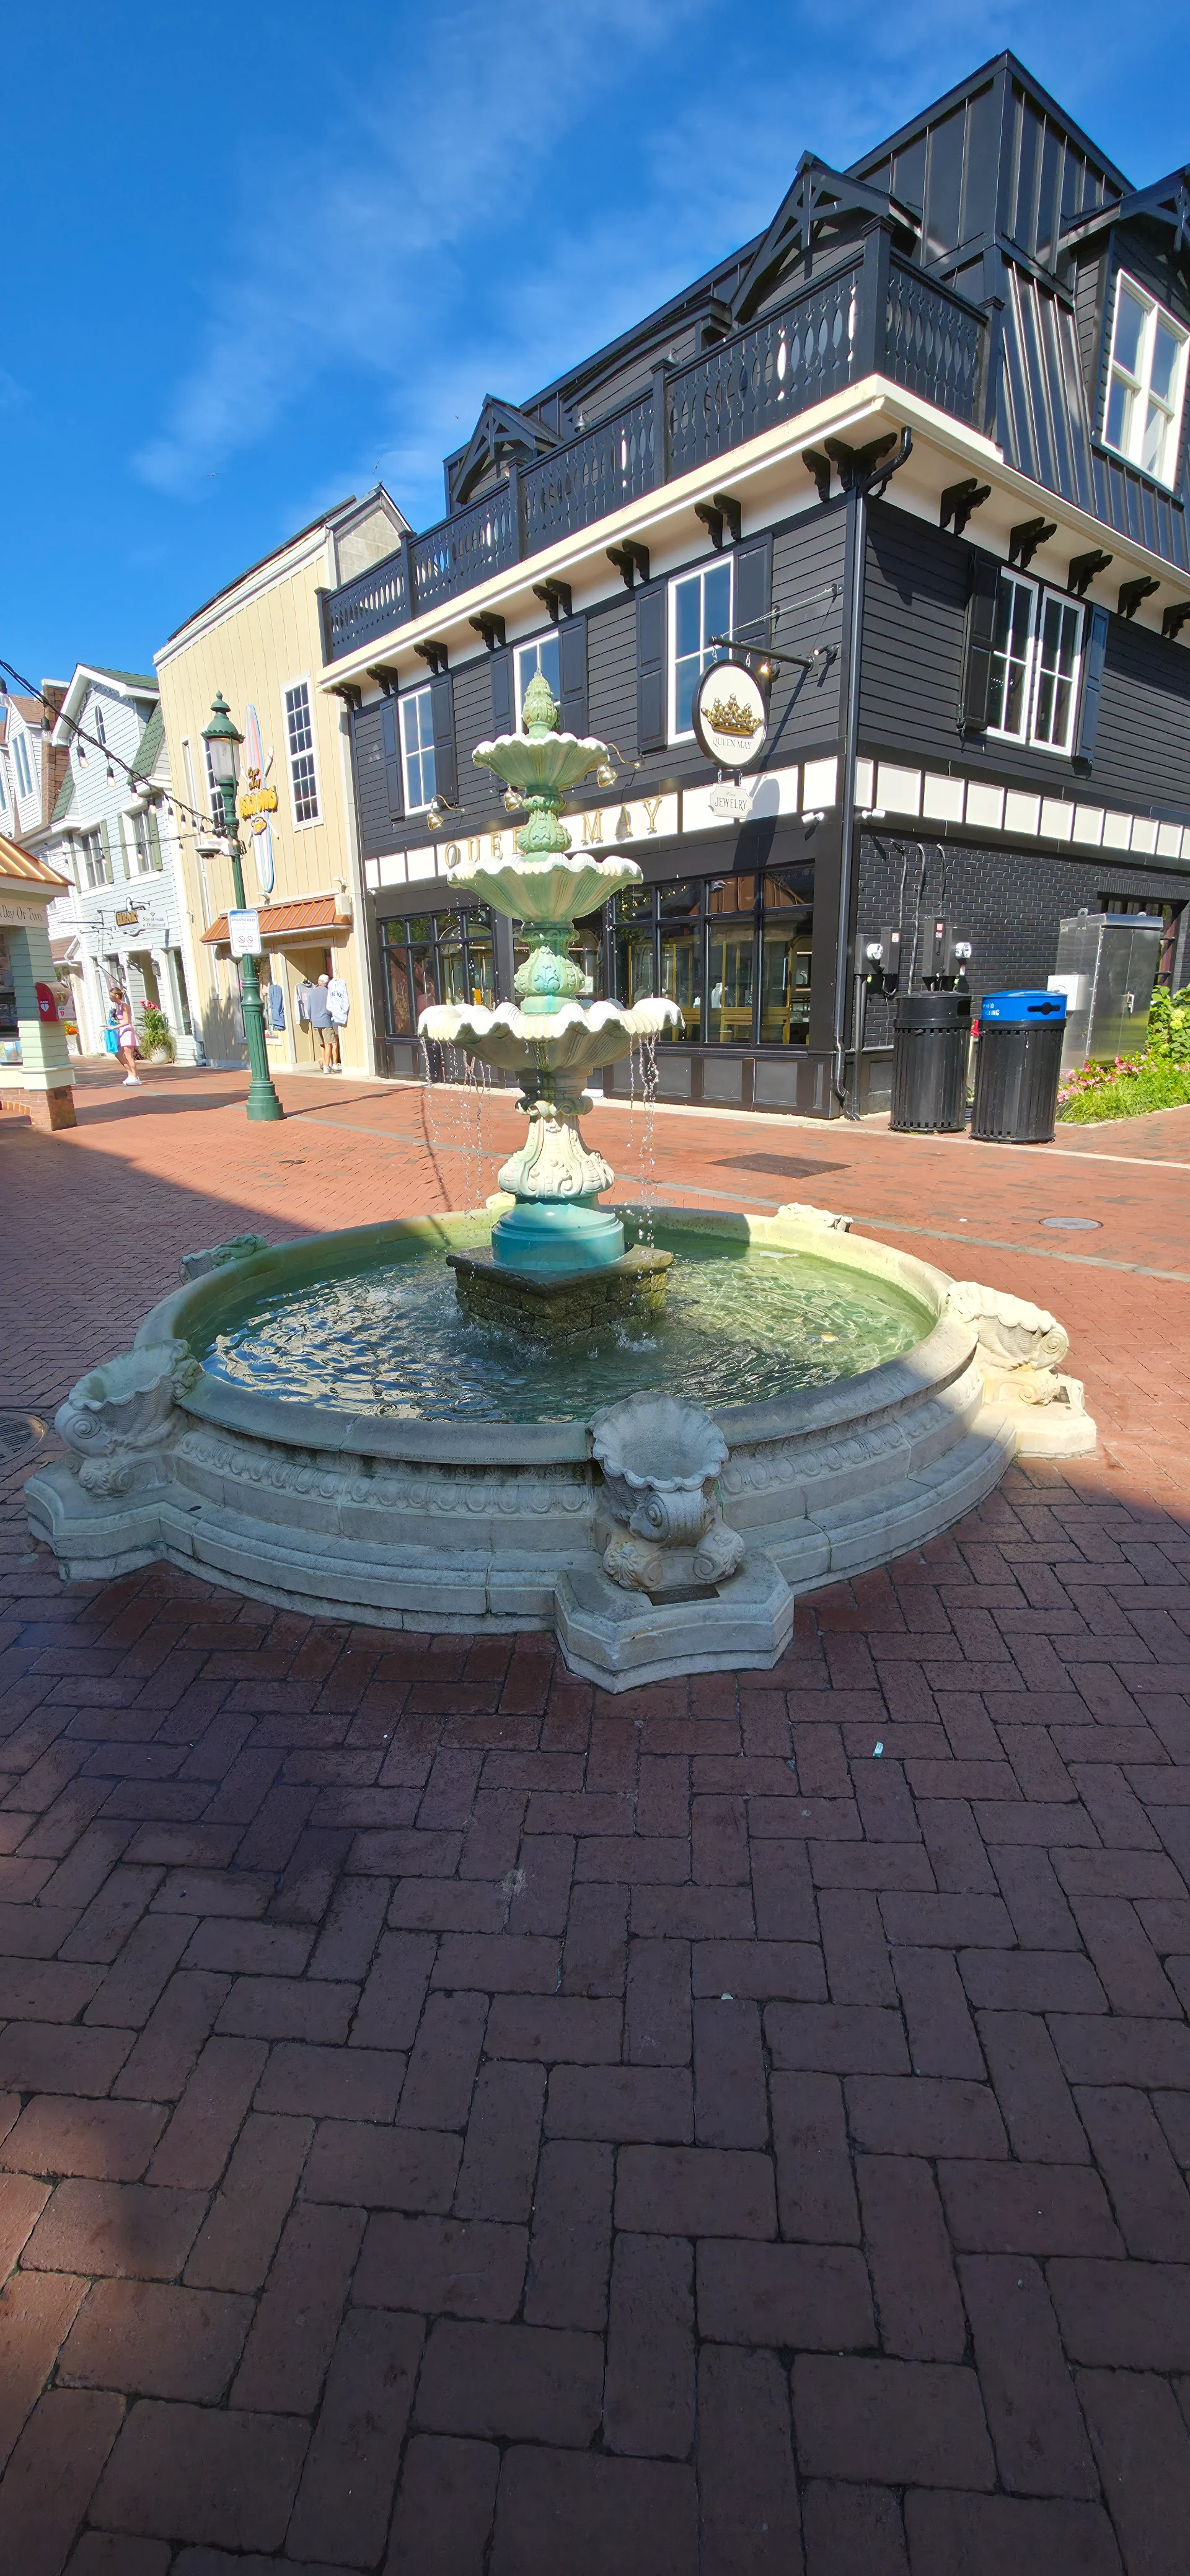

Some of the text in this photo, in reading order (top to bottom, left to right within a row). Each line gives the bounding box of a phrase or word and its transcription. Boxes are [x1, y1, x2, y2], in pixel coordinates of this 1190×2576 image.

[712, 737, 752, 750] QUEEN MAY
[714, 797, 747, 811] JEWELRY
[580, 796, 663, 845] MAY
